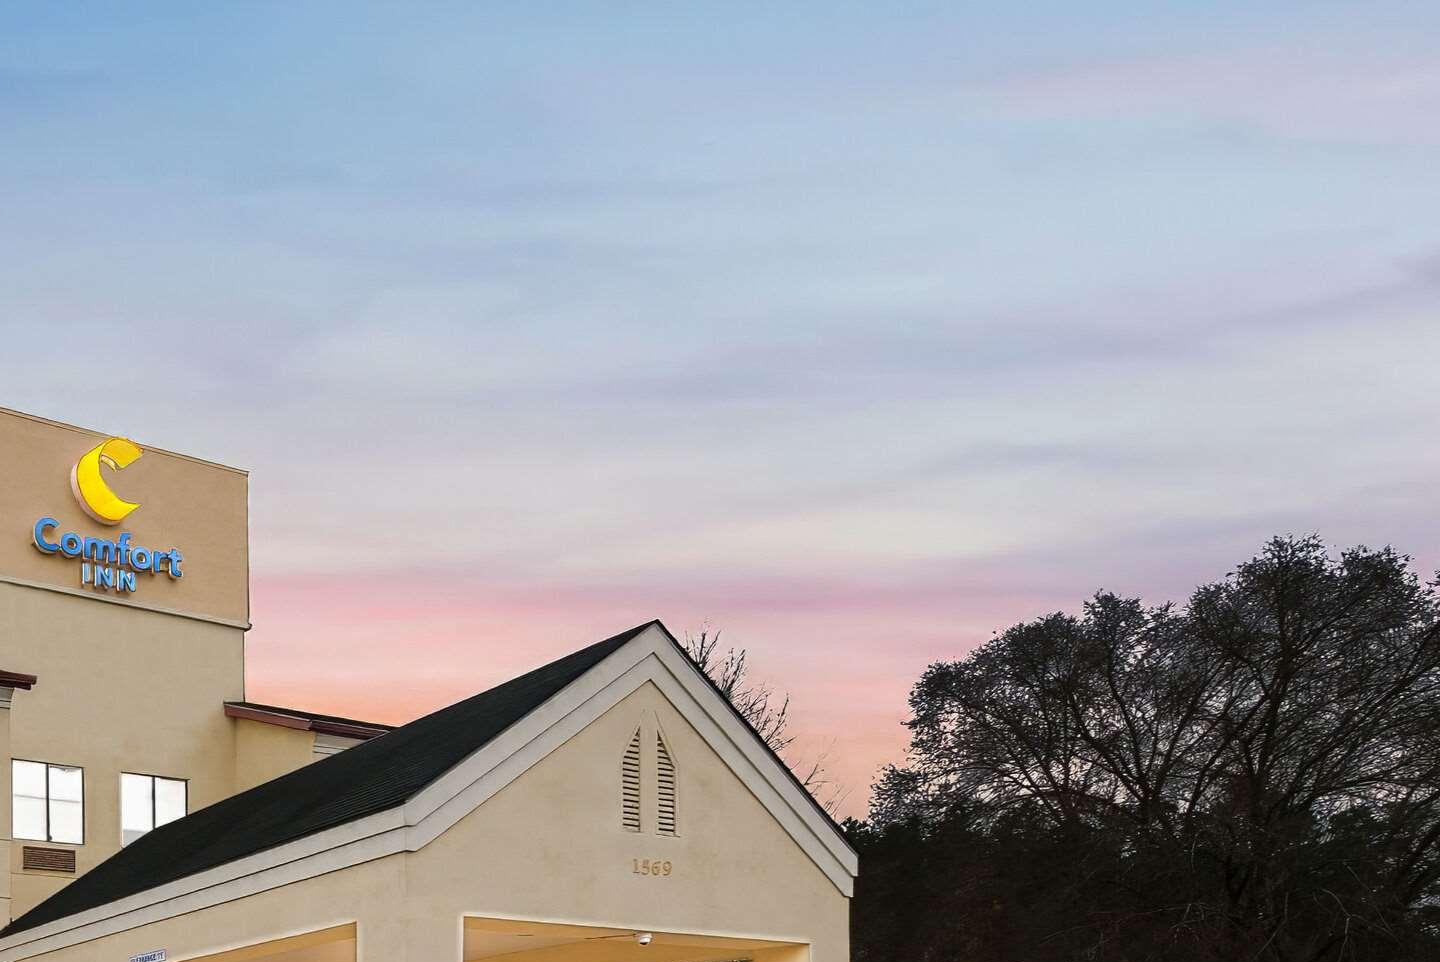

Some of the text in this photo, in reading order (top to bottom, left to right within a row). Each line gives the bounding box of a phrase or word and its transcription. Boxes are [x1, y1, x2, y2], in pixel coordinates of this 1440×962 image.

[33, 517, 183, 578] Comfort
[82, 562, 136, 592] INN
[632, 858, 672, 876] 1569
